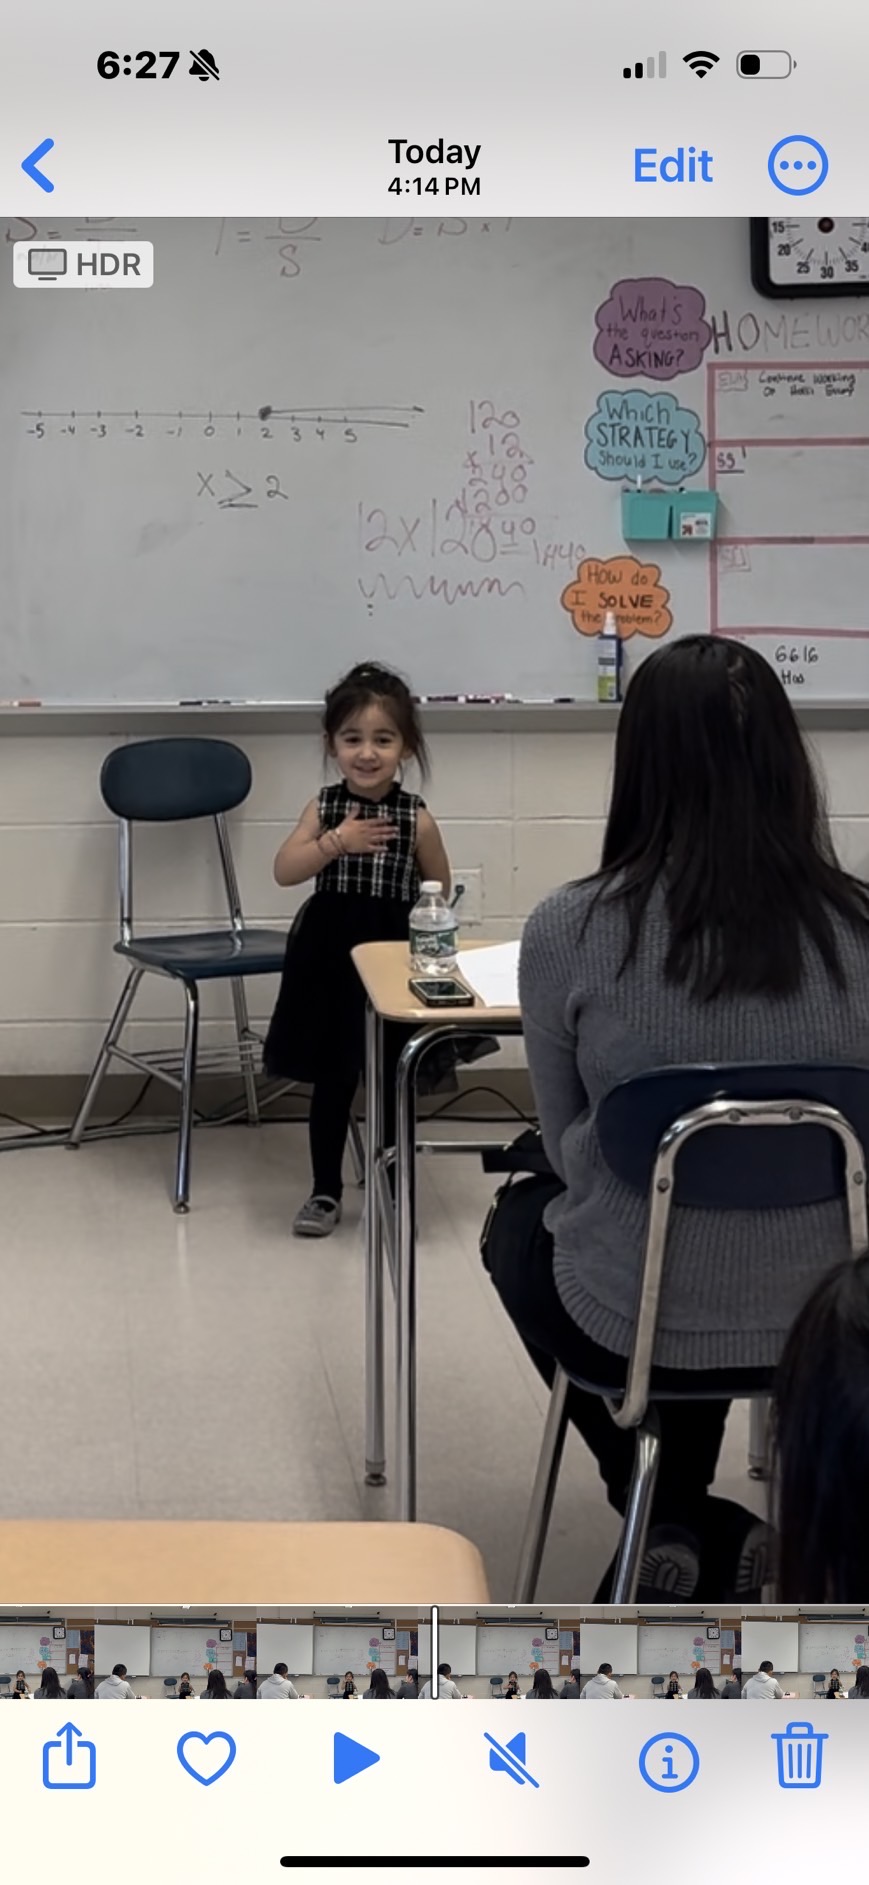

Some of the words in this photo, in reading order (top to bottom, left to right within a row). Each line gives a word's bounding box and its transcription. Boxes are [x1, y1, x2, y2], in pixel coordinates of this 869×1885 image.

[772, 221, 785, 233] 15
[778, 244, 791, 256] 20
[797, 261, 810, 274] 25
[820, 266, 834, 279] 30
[845, 260, 859, 272] 35
[619, 296, 683, 325] What's
[607, 323, 629, 339] the
[641, 327, 700, 349] question
[609, 345, 684, 369] ASKING?
[469, 399, 521, 434] 120
[605, 397, 670, 424] Which
[27, 423, 45, 438] -5
[60, 425, 76, 437] -4
[90, 425, 107, 438] -3
[125, 425, 144, 438] -2
[203, 425, 216, 437] 0
[261, 428, 274, 439] 2
[292, 427, 302, 443] 3
[316, 427, 325, 440] 4
[597, 422, 690, 454] STRATEGY
[598, 450, 646, 467] Should
[651, 453, 663, 469] I
[668, 452, 697, 471] use?
[631, 571, 649, 585] do
[571, 589, 587, 607] I
[598, 591, 654, 609] SOLVE
[581, 610, 602, 623] the
[615, 610, 662, 626] roblem?
